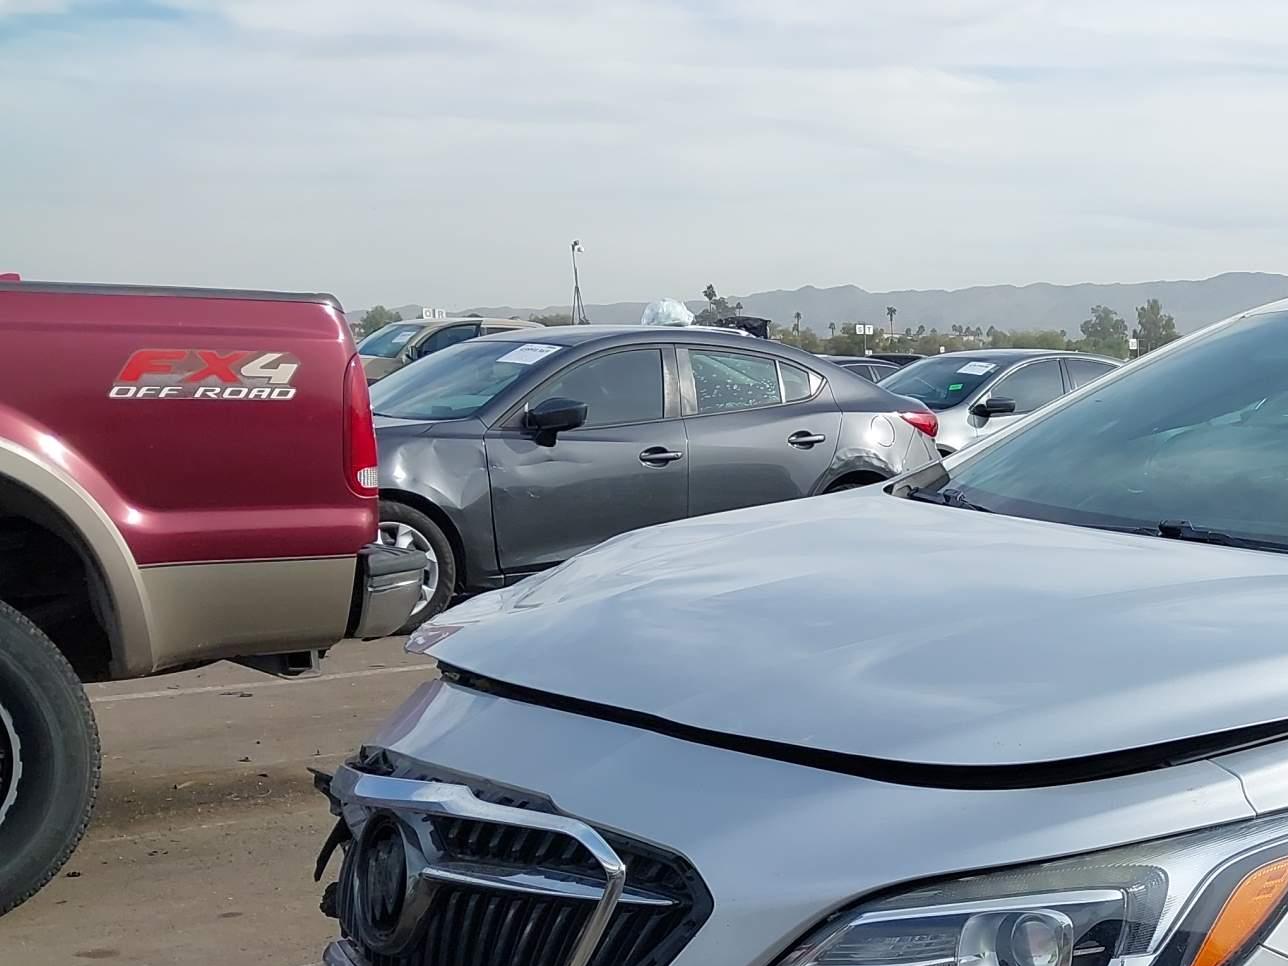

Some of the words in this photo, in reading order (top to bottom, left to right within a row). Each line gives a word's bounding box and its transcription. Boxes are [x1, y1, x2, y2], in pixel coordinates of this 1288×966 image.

[118, 351, 298, 384] FX4
[109, 386, 182, 399] OFF
[194, 386, 297, 399] ROAD
